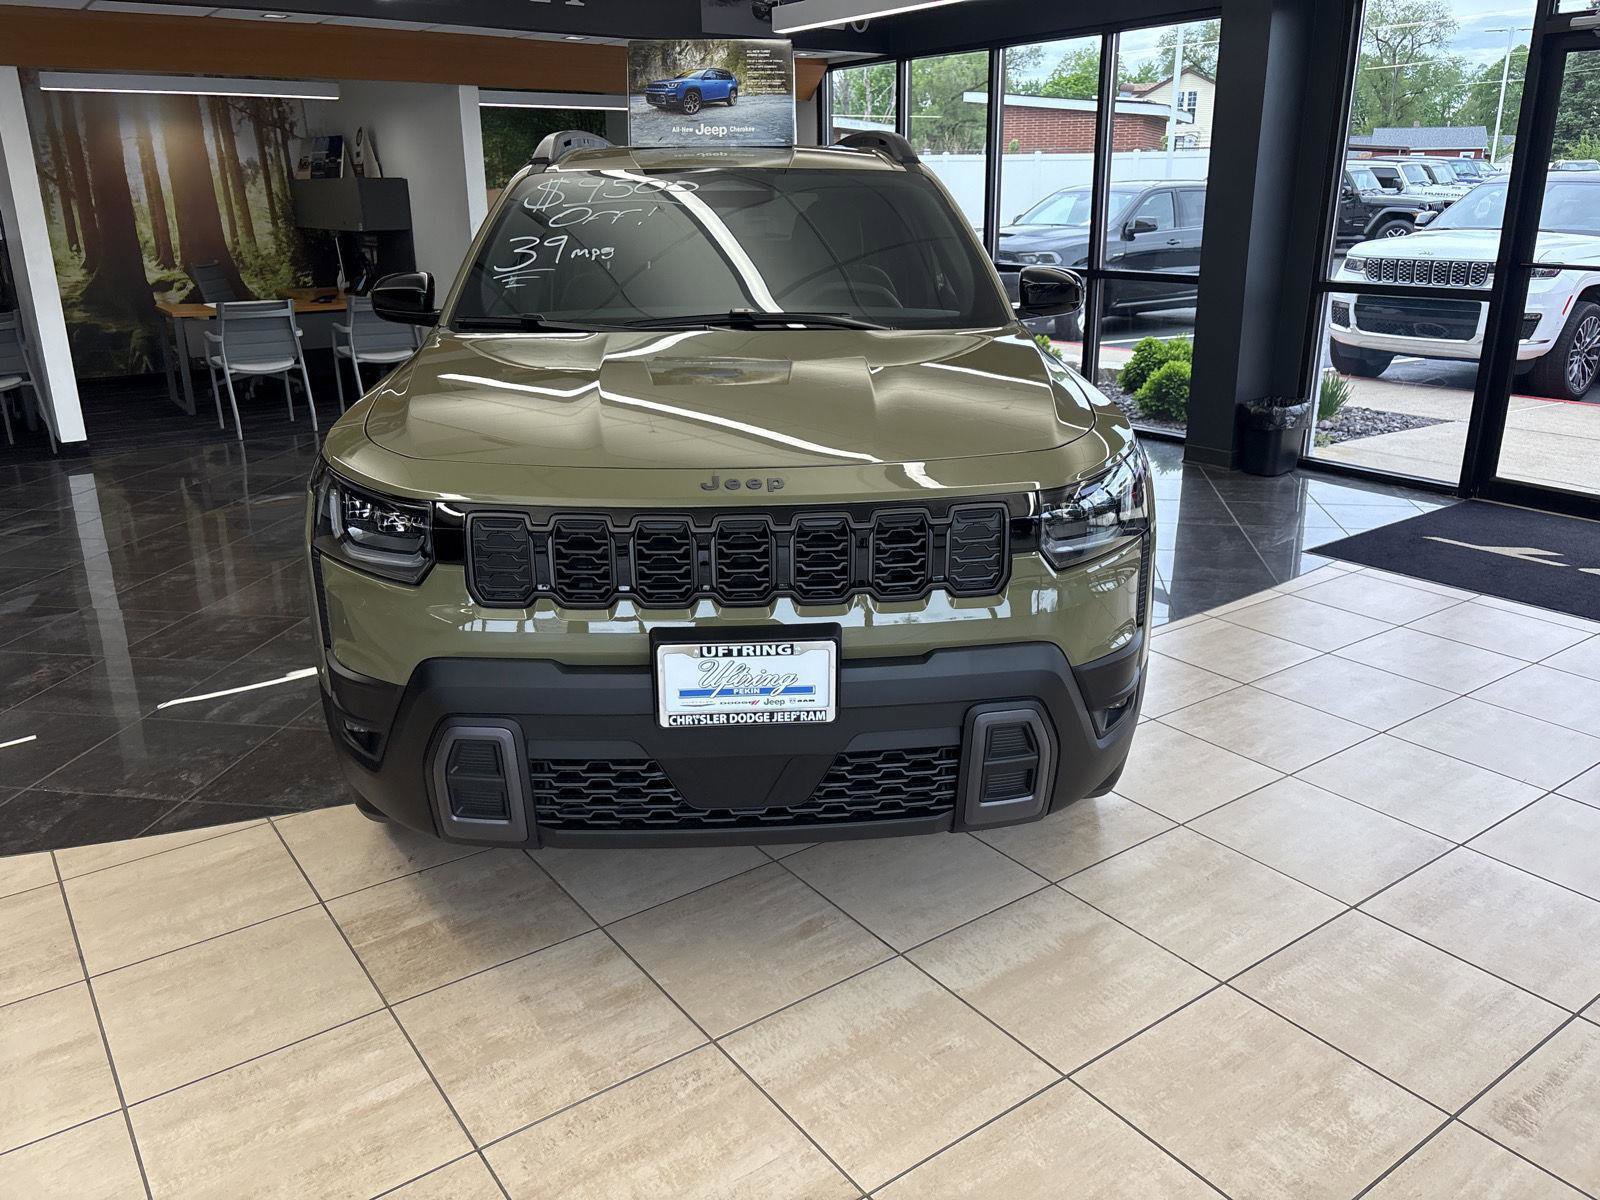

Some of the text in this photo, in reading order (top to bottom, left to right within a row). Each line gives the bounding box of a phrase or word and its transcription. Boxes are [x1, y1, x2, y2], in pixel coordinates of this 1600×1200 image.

[695, 123, 728, 137] Jeep
[493, 235, 569, 272] 39
[700, 475, 785, 492] Jeep
[702, 644, 792, 657] UFTRING
[697, 659, 799, 698] Uftring
[733, 687, 761, 695] PEKIN
[763, 698, 786, 706] Jeep
[669, 713, 728, 726] CHRYSLER
[729, 711, 770, 724] DODGE
[801, 710, 826, 722] RAM
